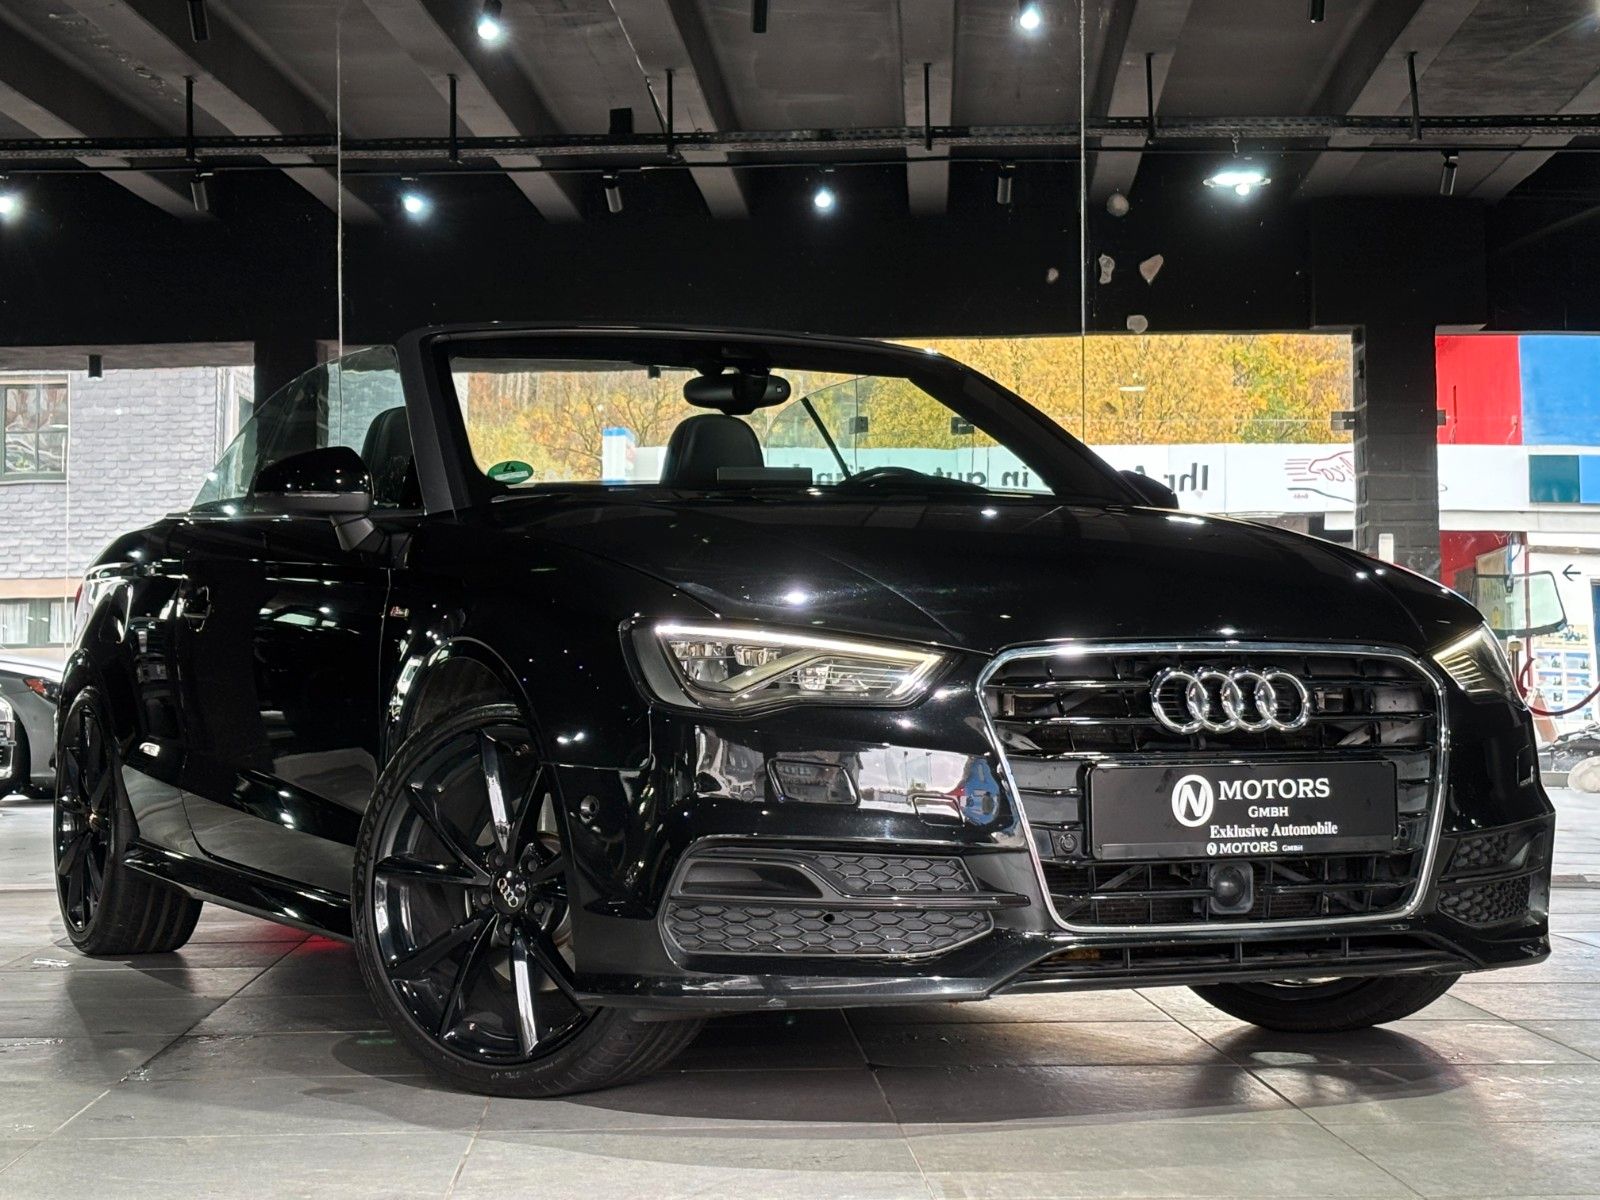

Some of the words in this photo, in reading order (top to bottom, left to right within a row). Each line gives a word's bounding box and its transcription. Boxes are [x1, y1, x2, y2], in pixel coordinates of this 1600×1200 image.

[503, 462, 516, 473] 4
[1218, 778, 1330, 800] MOTORS
[1210, 824, 1269, 839] Exklusive
[1271, 821, 1338, 837] Automobile
[1219, 841, 1278, 854] MOTORS
